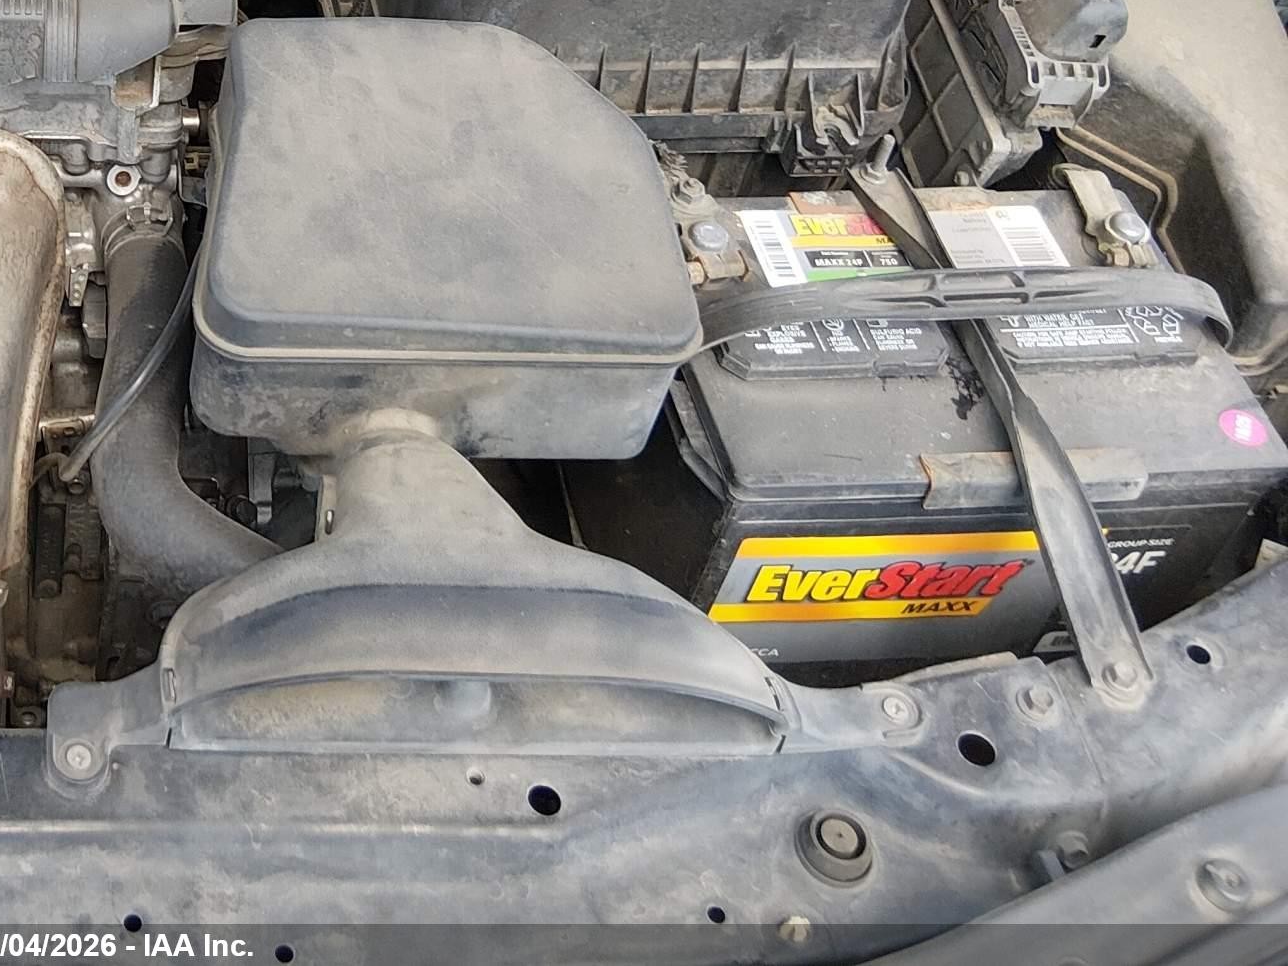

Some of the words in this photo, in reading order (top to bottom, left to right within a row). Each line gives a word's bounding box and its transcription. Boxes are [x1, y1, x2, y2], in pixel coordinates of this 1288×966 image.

[1107, 539, 1147, 548] GROUP
[745, 559, 1026, 603] EverStart
[901, 600, 979, 615] MAXX
